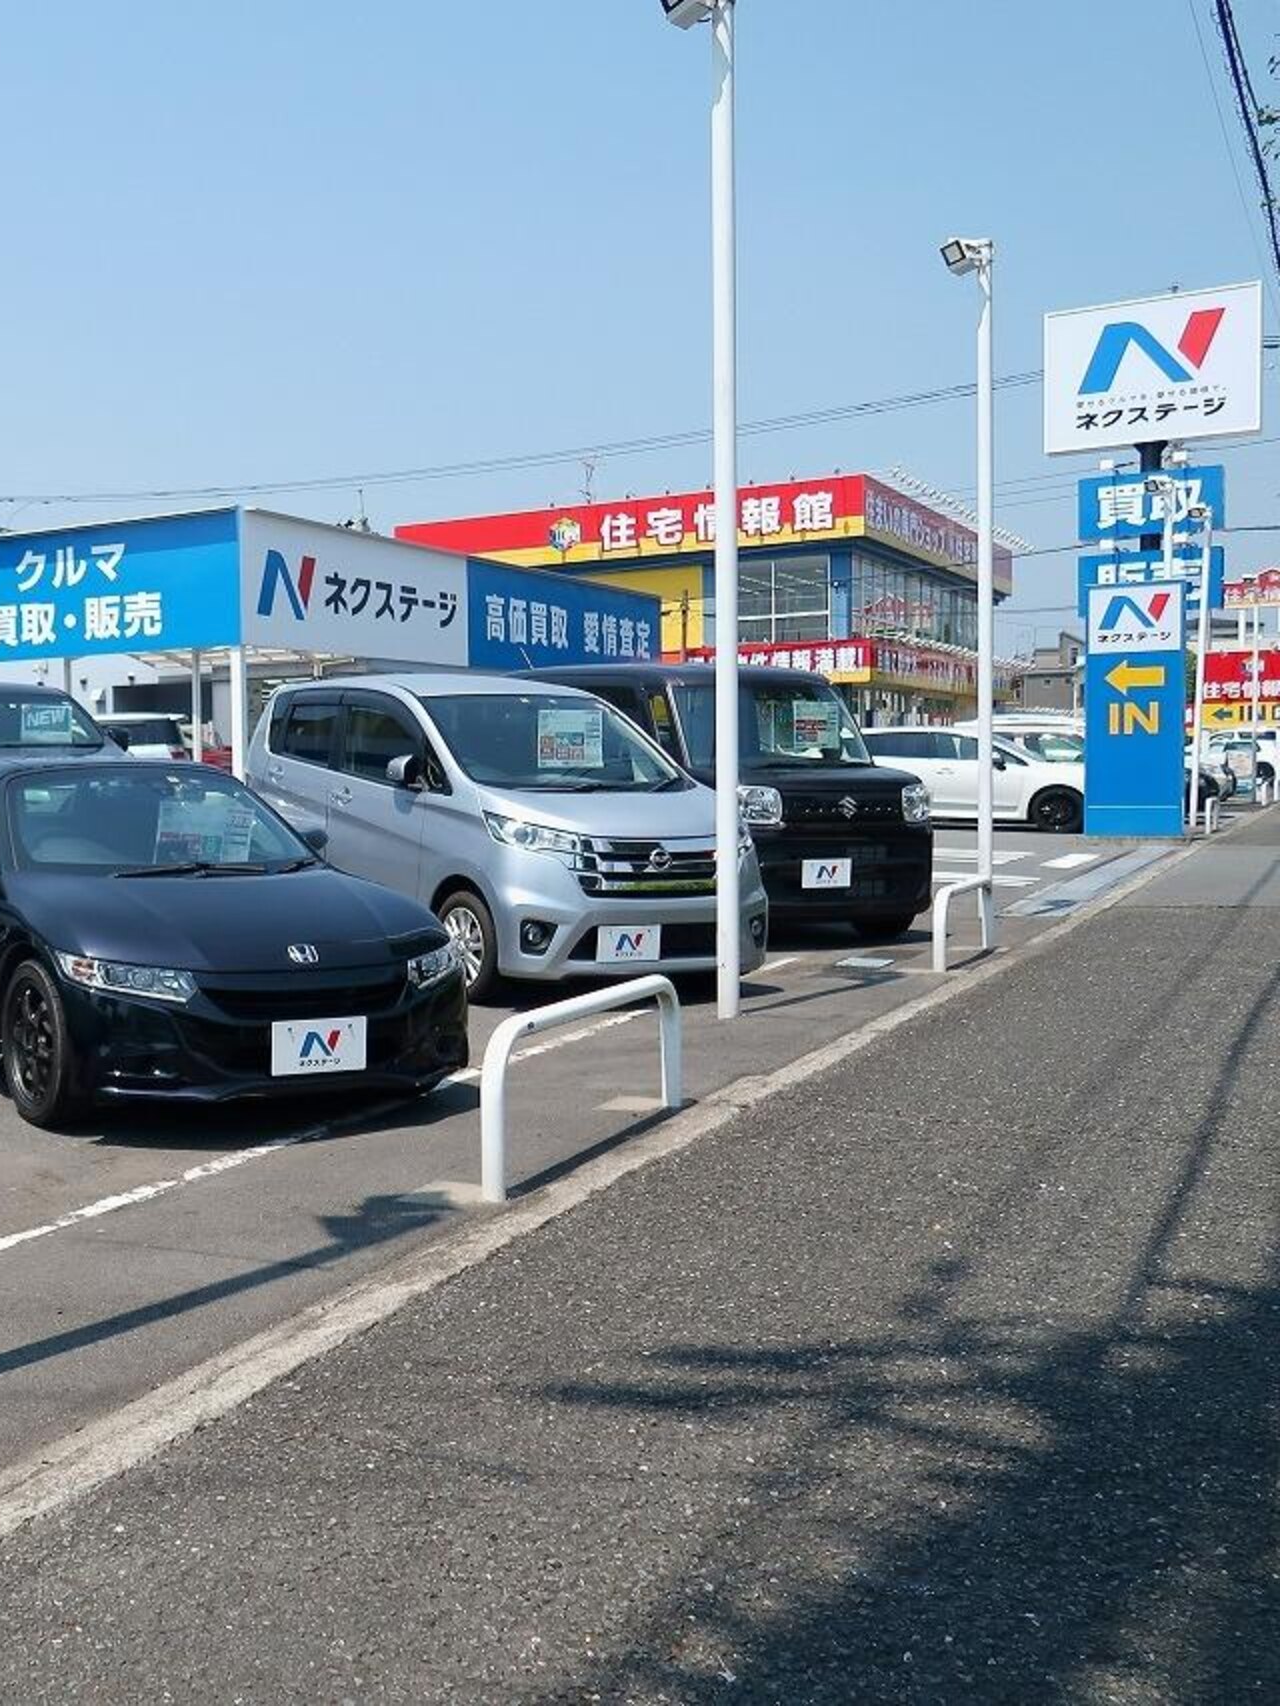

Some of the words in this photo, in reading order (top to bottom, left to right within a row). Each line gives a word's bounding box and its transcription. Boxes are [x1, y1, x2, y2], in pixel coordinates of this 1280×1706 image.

[1076, 397, 1227, 430] ネクステージ
[600, 491, 834, 551] 住宅情報館
[15, 543, 125, 592] クルマ
[324, 572, 458, 629] ネクステージ
[485, 594, 569, 649] 高価買取
[583, 611, 651, 659] 愛情査定
[27, 708, 67, 727] NEW
[1108, 701, 1159, 735] IN
